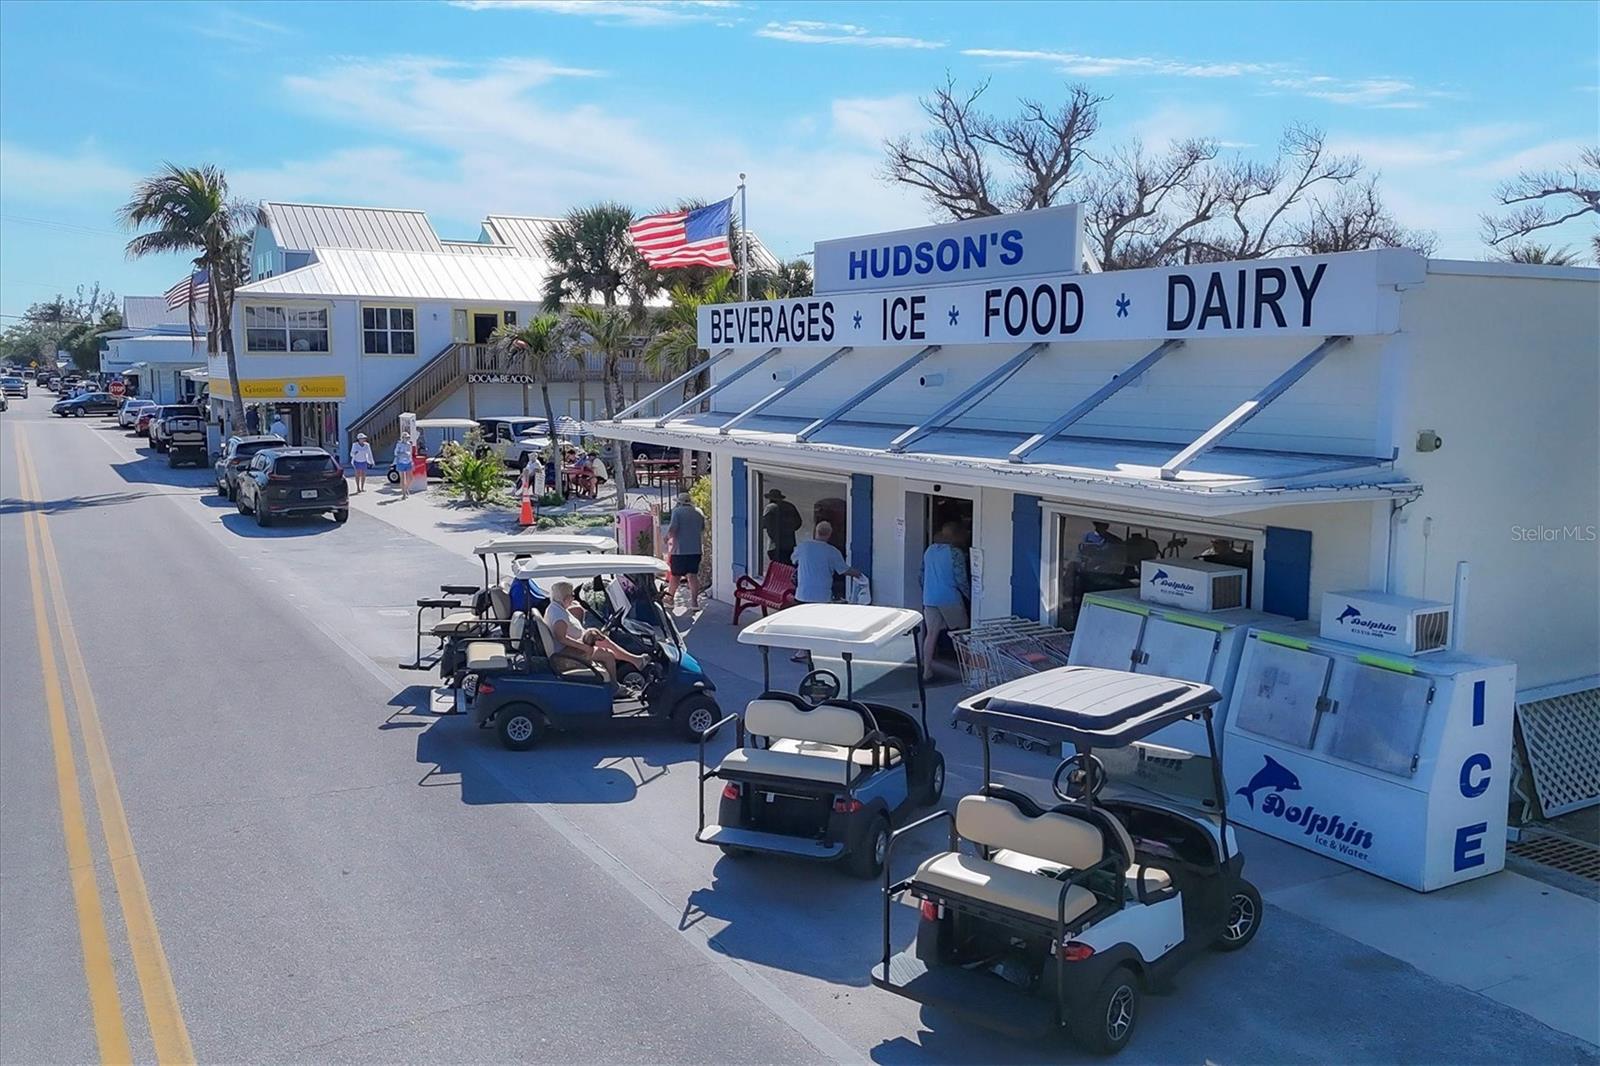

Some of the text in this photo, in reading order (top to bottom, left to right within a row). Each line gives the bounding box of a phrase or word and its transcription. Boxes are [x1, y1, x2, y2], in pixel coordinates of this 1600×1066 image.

[848, 229, 1024, 281] HUDSON'S
[710, 263, 1328, 344] BEVERAGES ICE FOOD DAIRY
[110, 385, 124, 393] STOP
[468, 374, 534, 384] BOCA BEACON
[1160, 579, 1195, 592] Dolphin
[1350, 617, 1398, 632] Dolphin
[1261, 792, 1374, 850] Dolphin
[1314, 834, 1328, 848] Ice
[1338, 843, 1369, 861] Water
